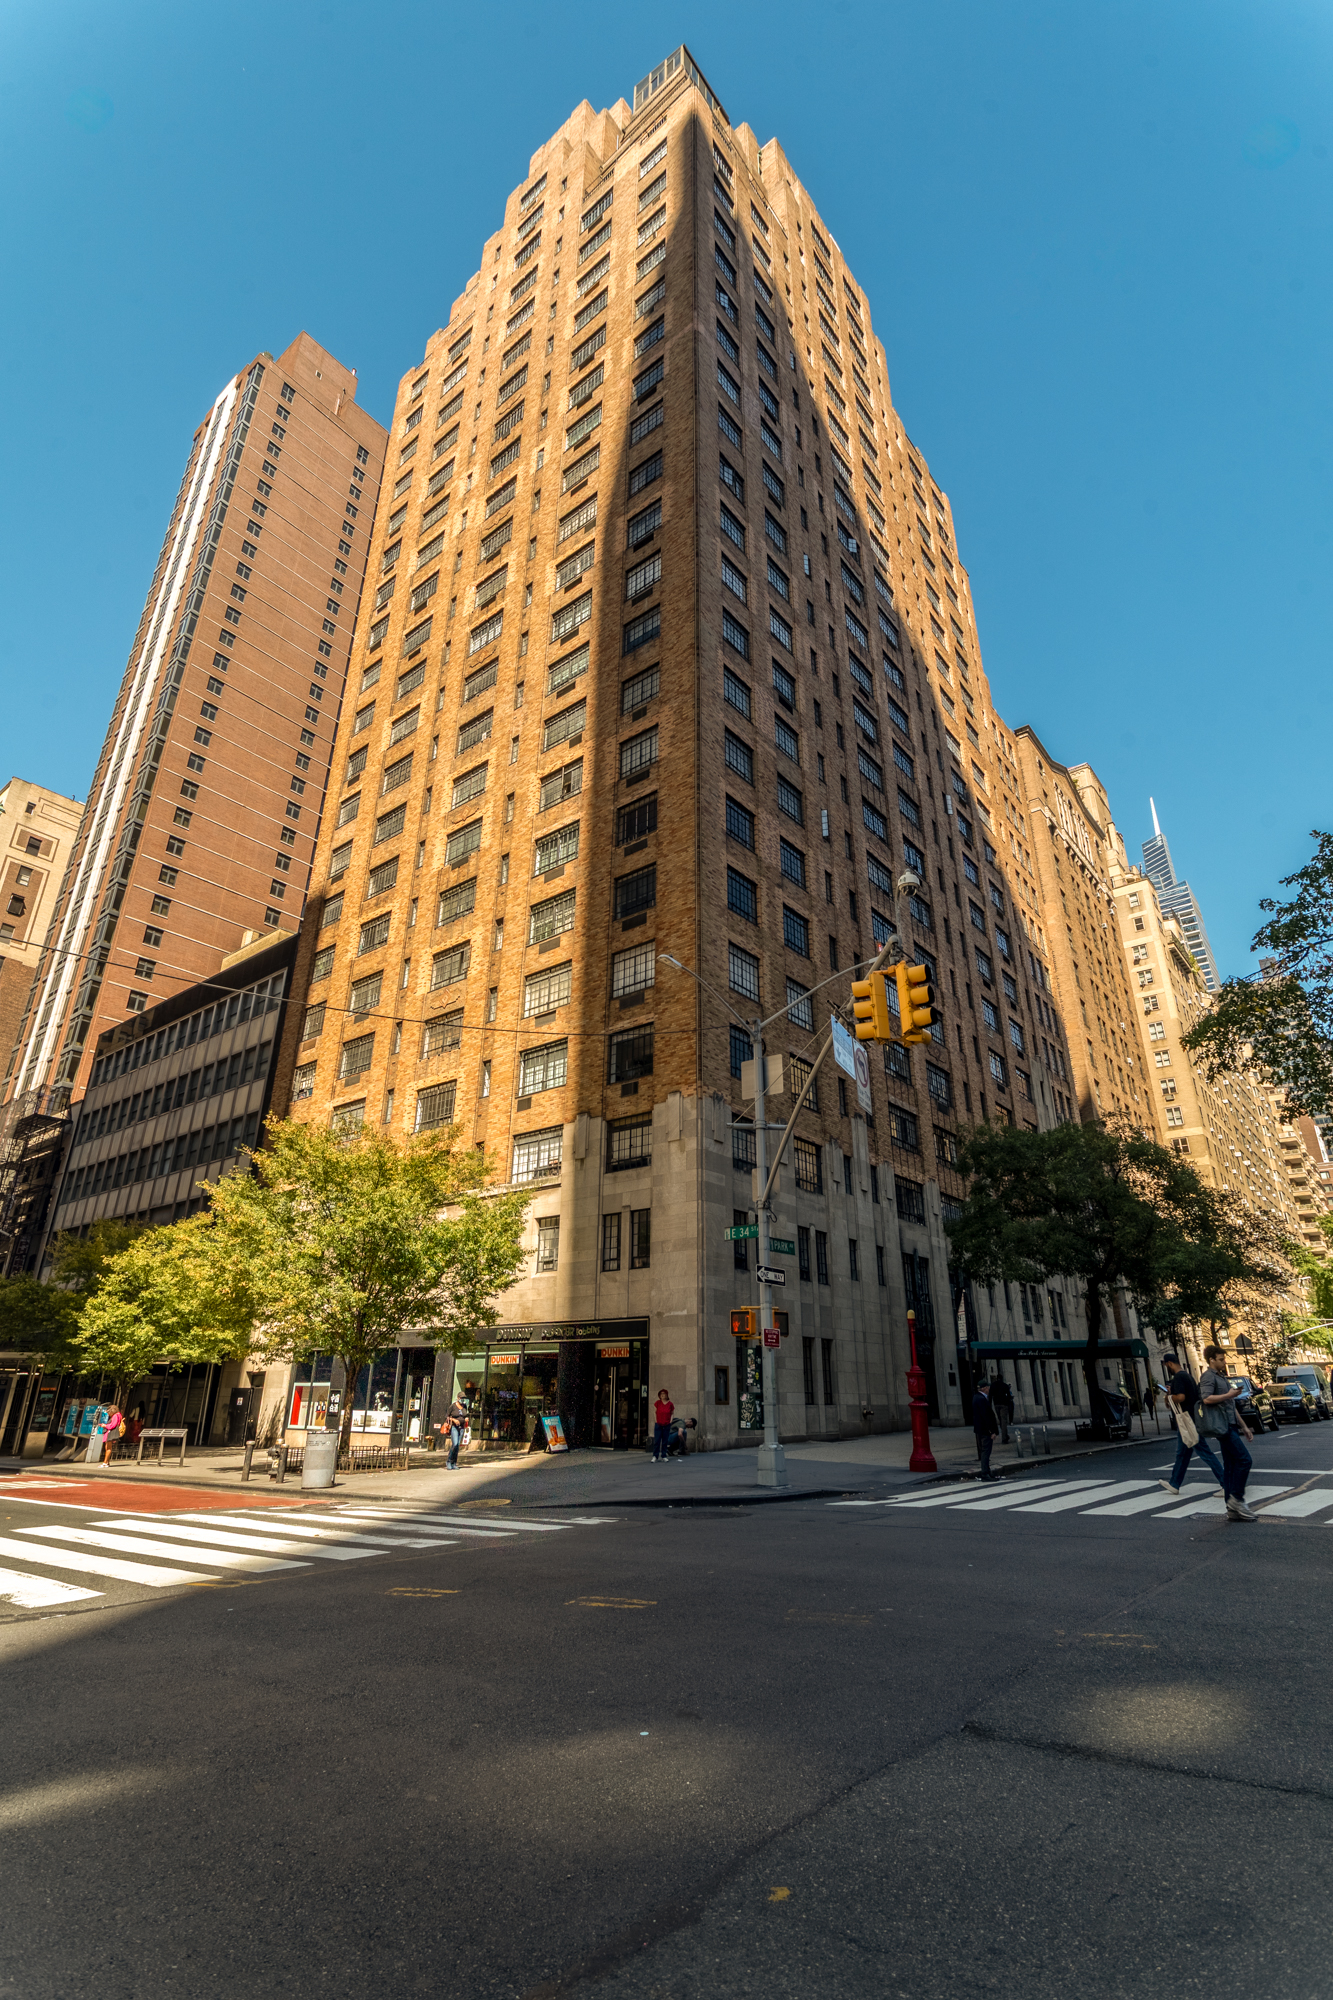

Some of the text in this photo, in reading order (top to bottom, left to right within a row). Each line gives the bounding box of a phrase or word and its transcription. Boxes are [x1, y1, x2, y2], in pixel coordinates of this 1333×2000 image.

[731, 1228, 737, 1238] E
[739, 1226, 750, 1237] 34
[774, 1240, 789, 1252] PARK
[760, 1270, 784, 1281] ONE WAY
